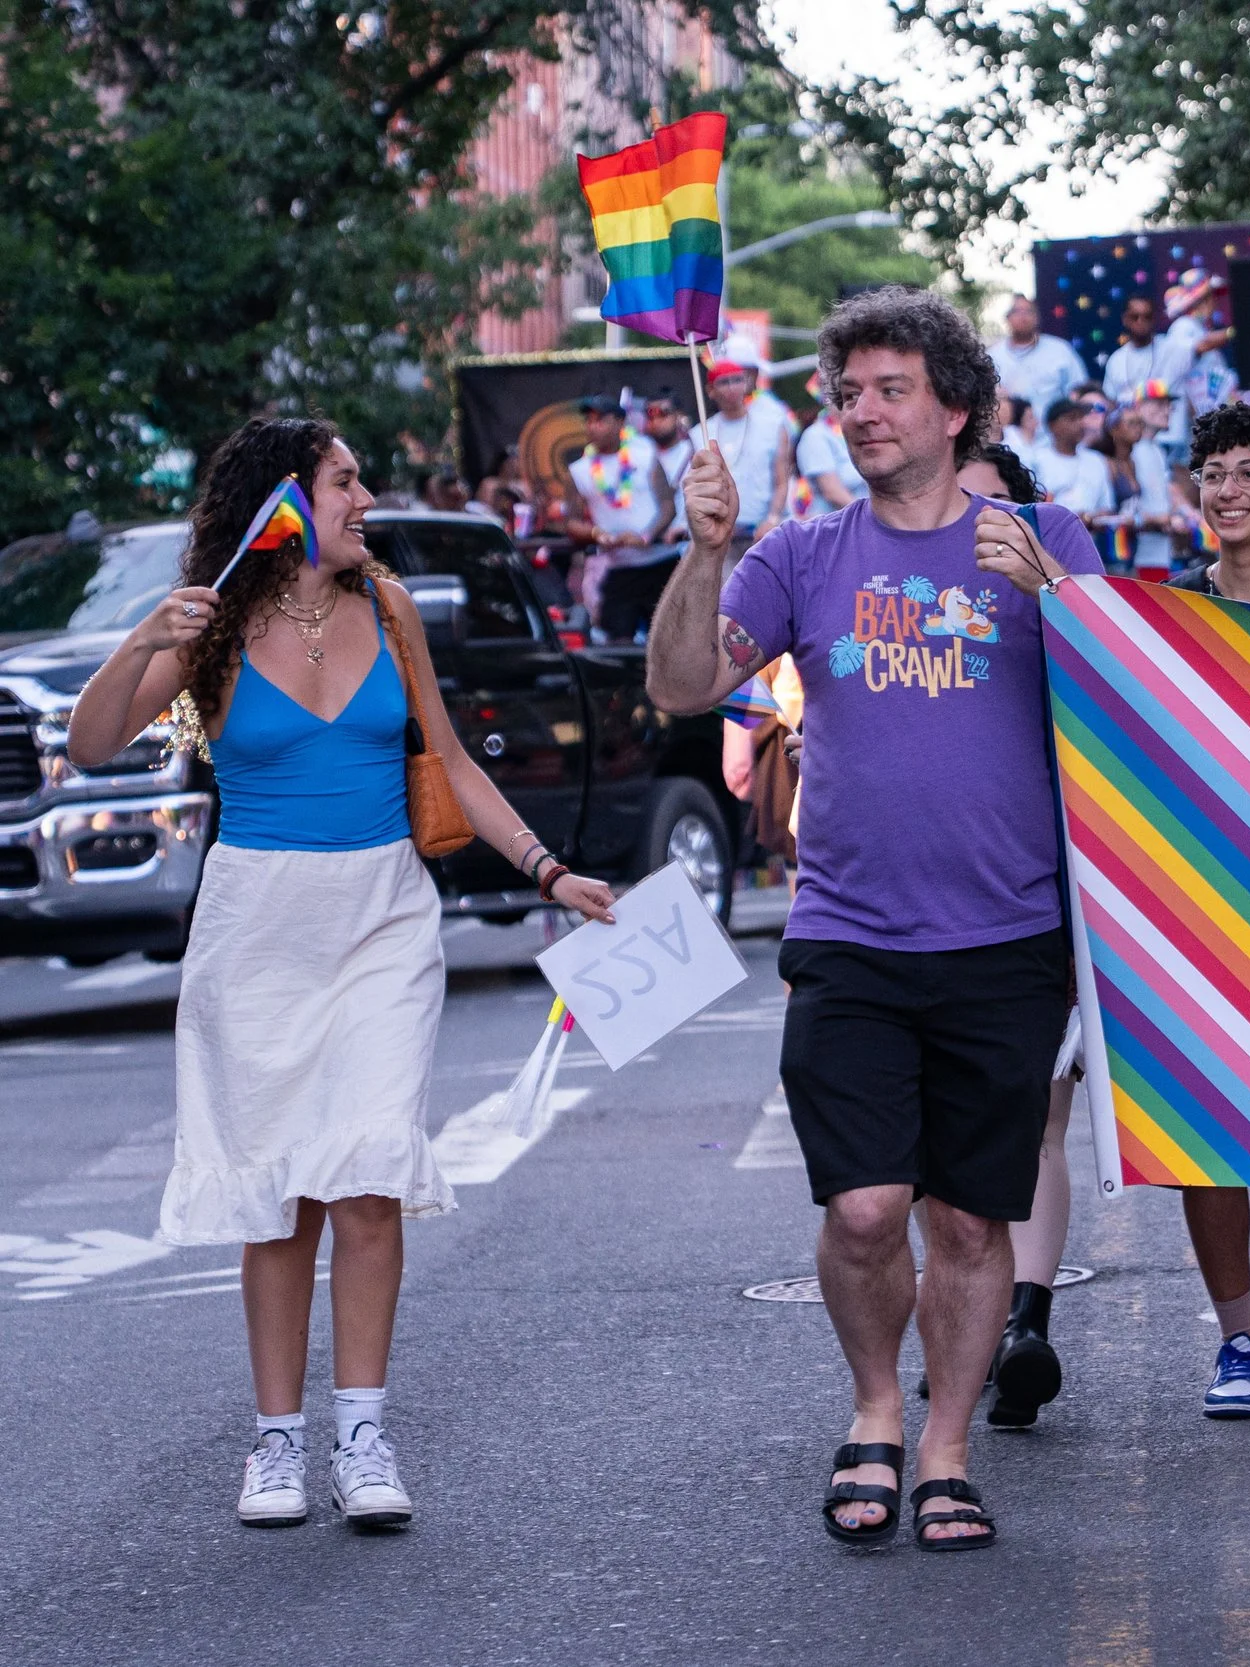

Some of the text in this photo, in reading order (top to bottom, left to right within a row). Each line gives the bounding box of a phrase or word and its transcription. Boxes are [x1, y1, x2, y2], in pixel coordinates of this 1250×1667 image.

[871, 574, 889, 582] MARK
[863, 581, 884, 590] FISHER
[875, 586, 899, 595] FITNESS
[864, 636, 975, 698] CRAWL
